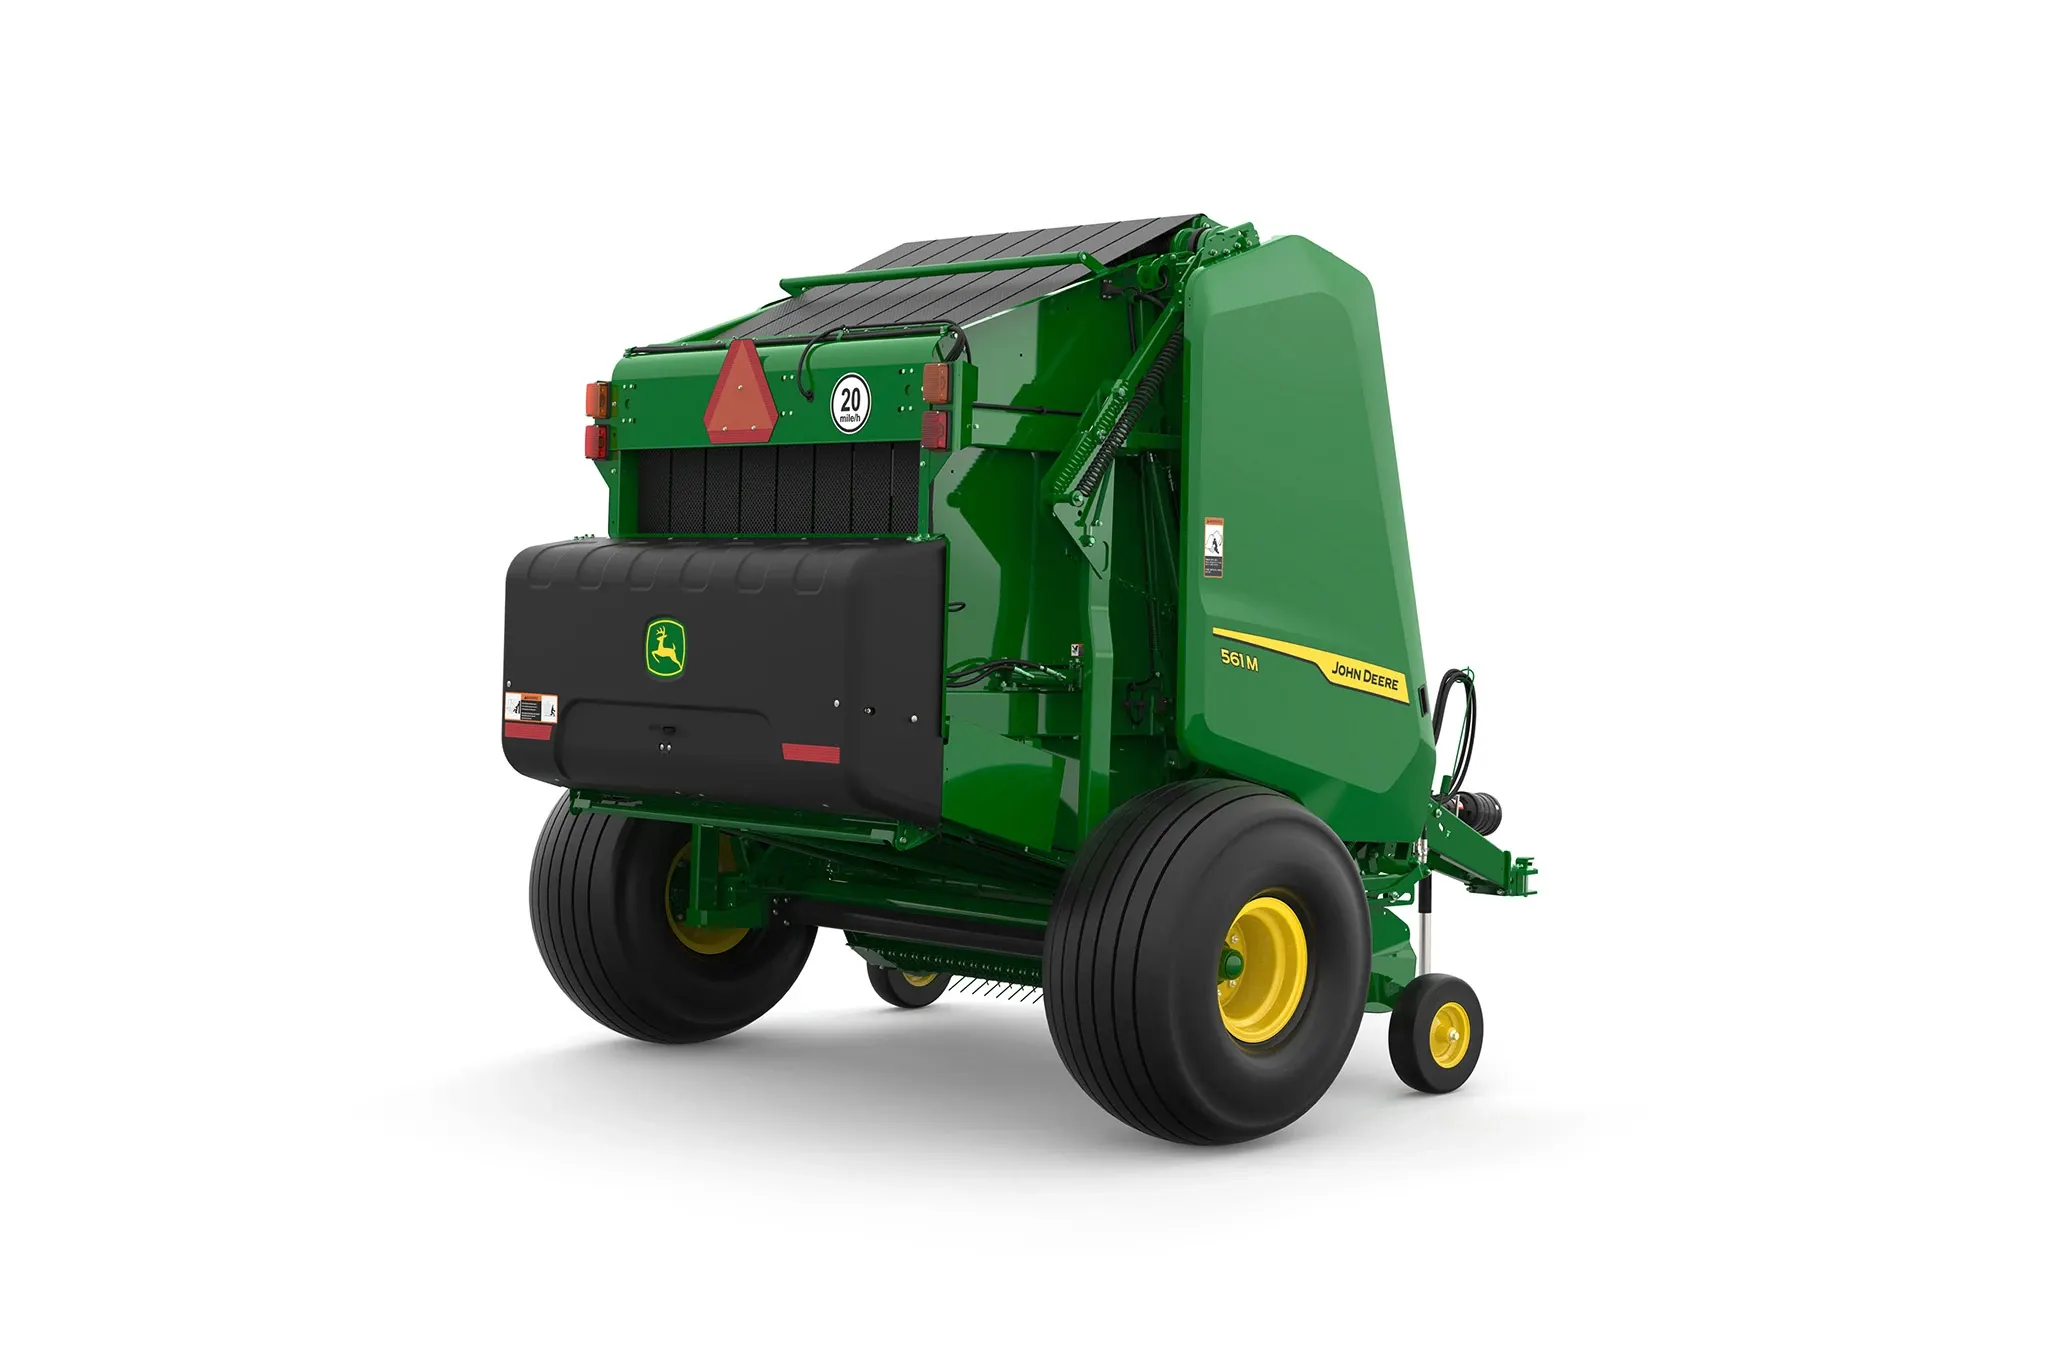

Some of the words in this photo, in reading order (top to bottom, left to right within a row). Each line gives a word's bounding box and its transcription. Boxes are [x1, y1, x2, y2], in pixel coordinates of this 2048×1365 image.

[841, 387, 860, 411] 20
[840, 413, 861, 422] mile/h
[1220, 648, 1244, 668] 561
[1246, 655, 1259, 672] M
[1332, 662, 1361, 680] JOHN
[1363, 670, 1398, 690] DEERE
